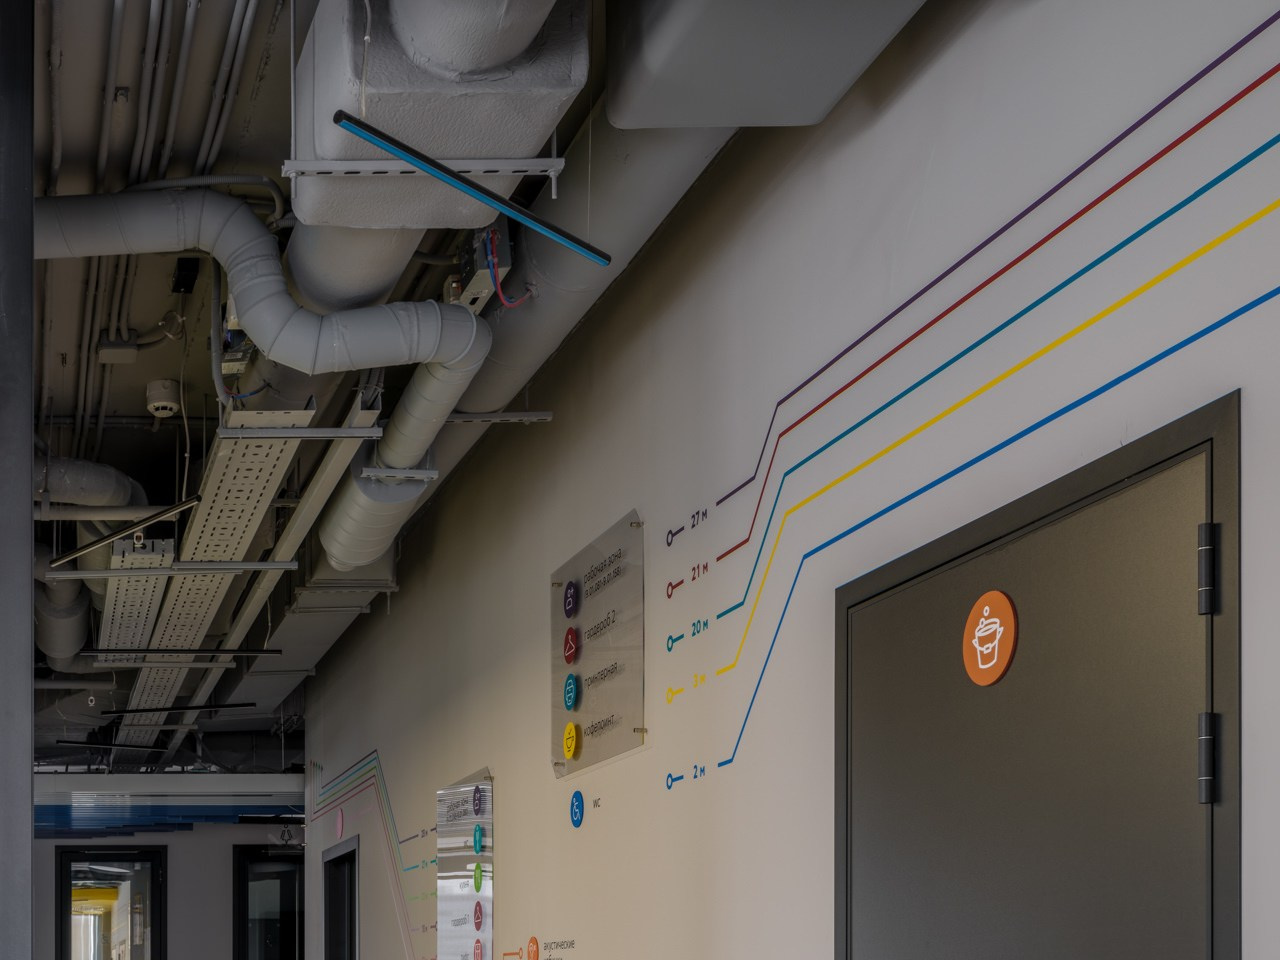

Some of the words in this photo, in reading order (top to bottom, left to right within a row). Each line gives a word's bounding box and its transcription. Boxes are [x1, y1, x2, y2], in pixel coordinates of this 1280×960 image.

[691, 511, 701, 528] 27
[584, 559, 606, 587] рабочая
[607, 548, 622, 566] зона
[691, 564, 701, 581] 21
[584, 613, 611, 641] гардероб
[611, 609, 616, 624] 2
[691, 621, 701, 637] 20
[584, 662, 618, 689] принтерная
[693, 673, 699, 688] 3
[584, 714, 615, 738] кофепоинт
[693, 765, 699, 779] 2
[592, 798, 601, 809] WC
[544, 940, 575, 953] акустические
